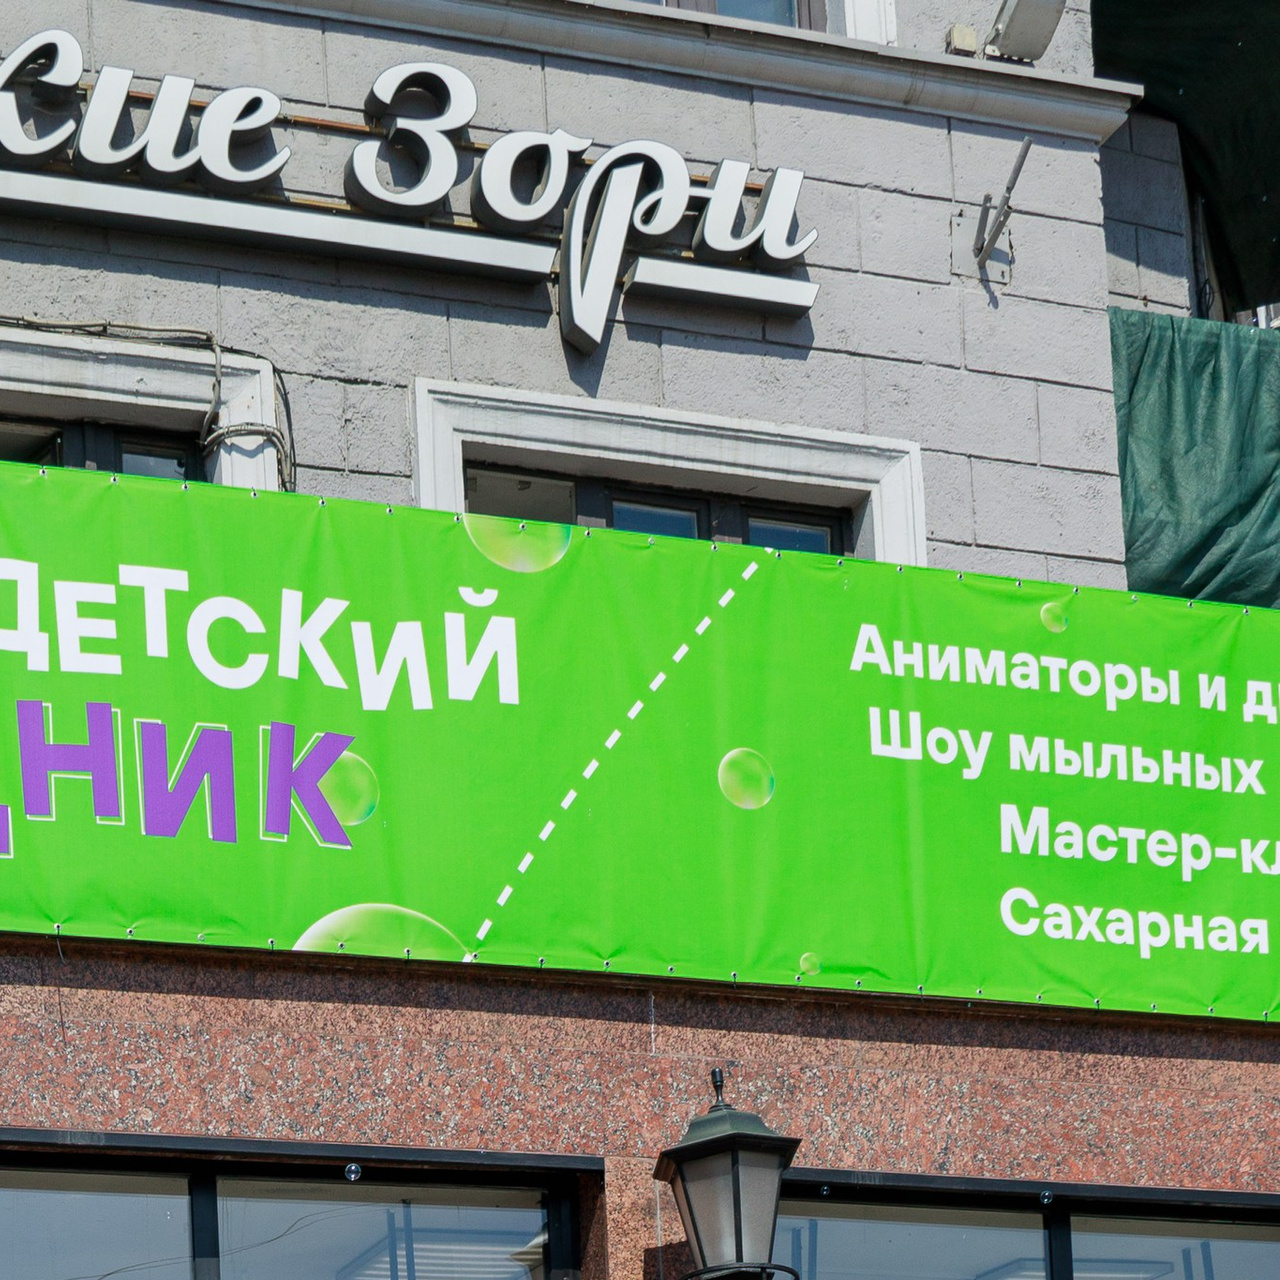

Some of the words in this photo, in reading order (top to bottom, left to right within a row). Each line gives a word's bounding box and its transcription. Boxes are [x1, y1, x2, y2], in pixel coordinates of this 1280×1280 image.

[344, 62, 819, 352] Зори
[849, 623, 1180, 711] Аниматоры
[1198, 673, 1227, 712] и
[1242, 680, 1280, 725] д
[869, 706, 993, 780] Шоу
[1009, 733, 1267, 796] мыльных
[999, 887, 1271, 960] Сахарная
